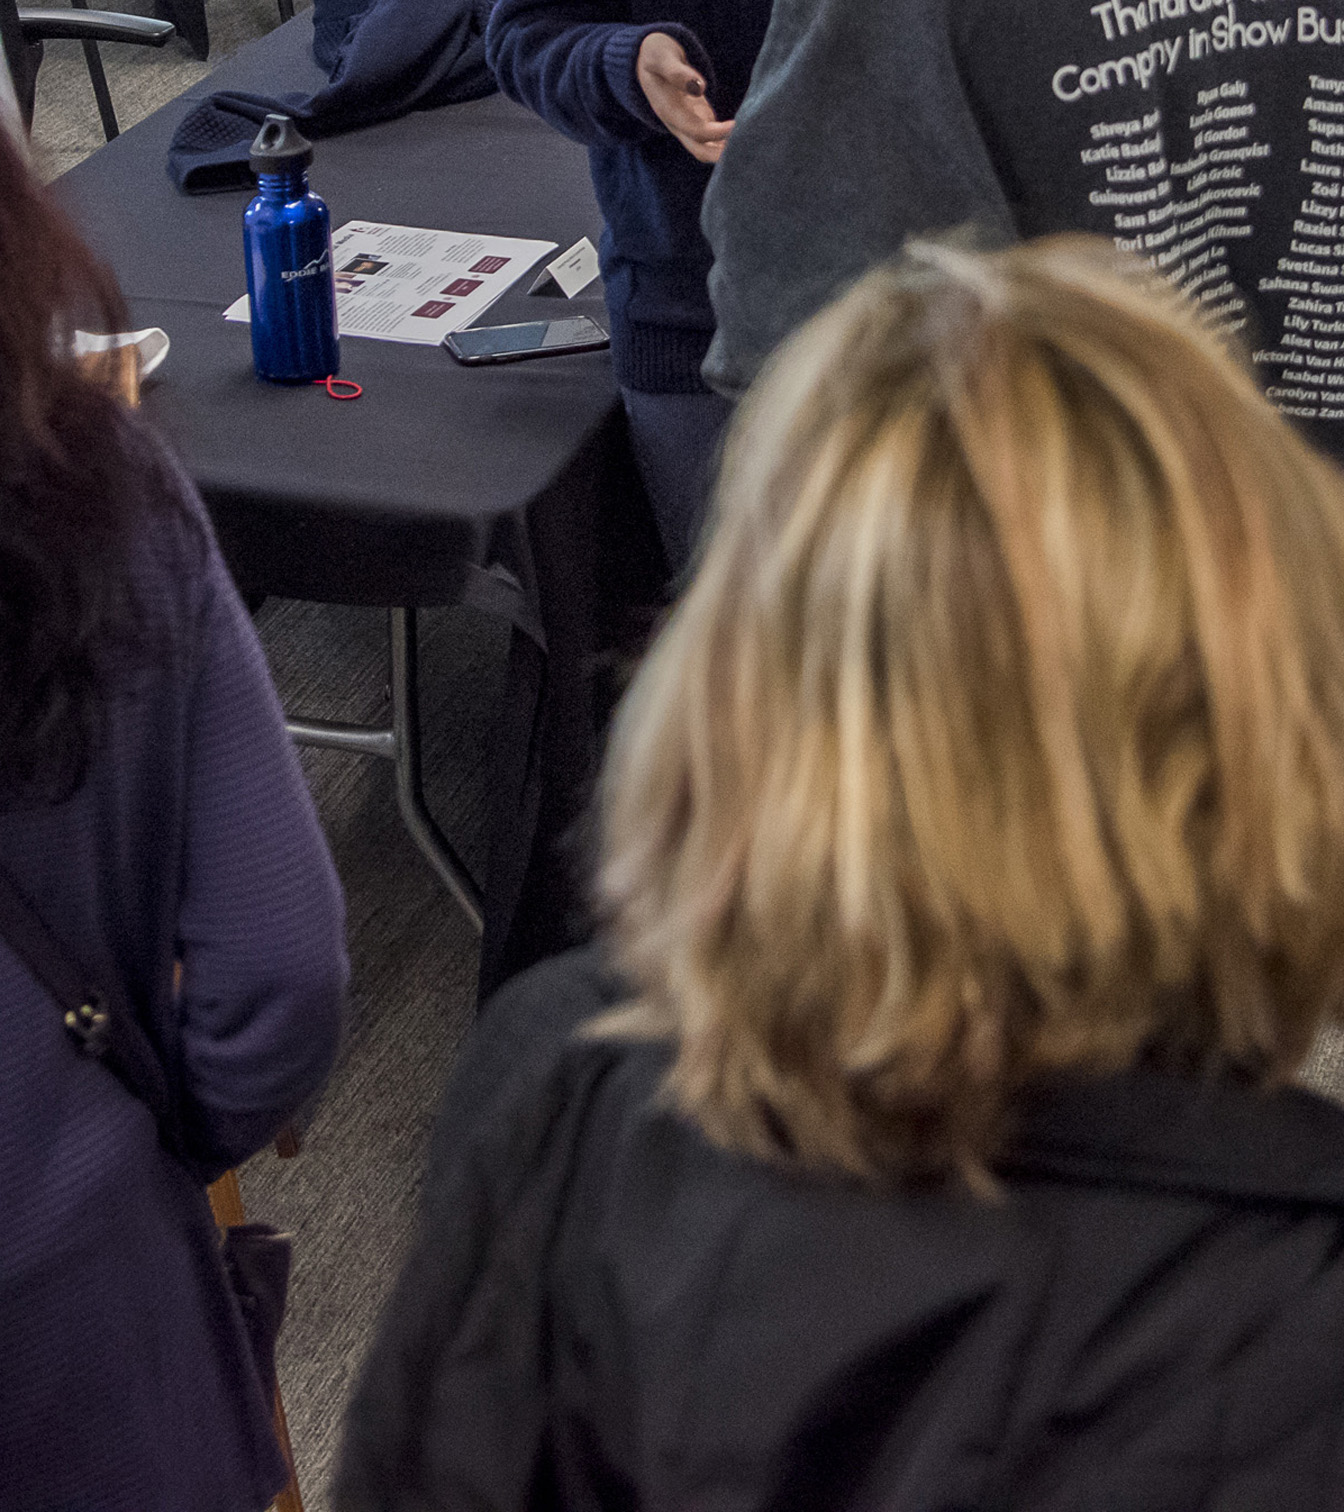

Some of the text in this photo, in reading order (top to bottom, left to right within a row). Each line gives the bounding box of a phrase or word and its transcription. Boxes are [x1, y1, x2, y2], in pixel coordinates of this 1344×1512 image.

[1052, 36, 1183, 101] Compny
[1189, 27, 1209, 59] in
[1211, 1, 1293, 52] Show
[1090, 119, 1141, 139] Shreya
[1203, 125, 1248, 143] Gordon
[1080, 143, 1120, 164] Katie
[1208, 142, 1270, 162] Granqvist
[1106, 163, 1147, 182] Lizzie
[1300, 158, 1342, 178] Laura
[1089, 188, 1157, 206] Guinevere
[1311, 181, 1340, 197] Zoë
[1301, 199, 1339, 219] Lizzy
[1114, 213, 1147, 229] Sam
[1293, 219, 1338, 237] Raziel
[1290, 239, 1332, 256] Lucas
[281, 266, 318, 279] EDDIE
[1277, 257, 1339, 276] Svetlana
[1258, 276, 1309, 291] Sahana
[1288, 296, 1333, 314] Zahira
[1283, 315, 1311, 332] Lily
[1280, 333, 1312, 348] Alex
[1314, 340, 1339, 351] van
[1252, 349, 1332, 368] Victoria Van
[1281, 369, 1325, 385] Isabel
[1265, 386, 1318, 402] Carolyn
